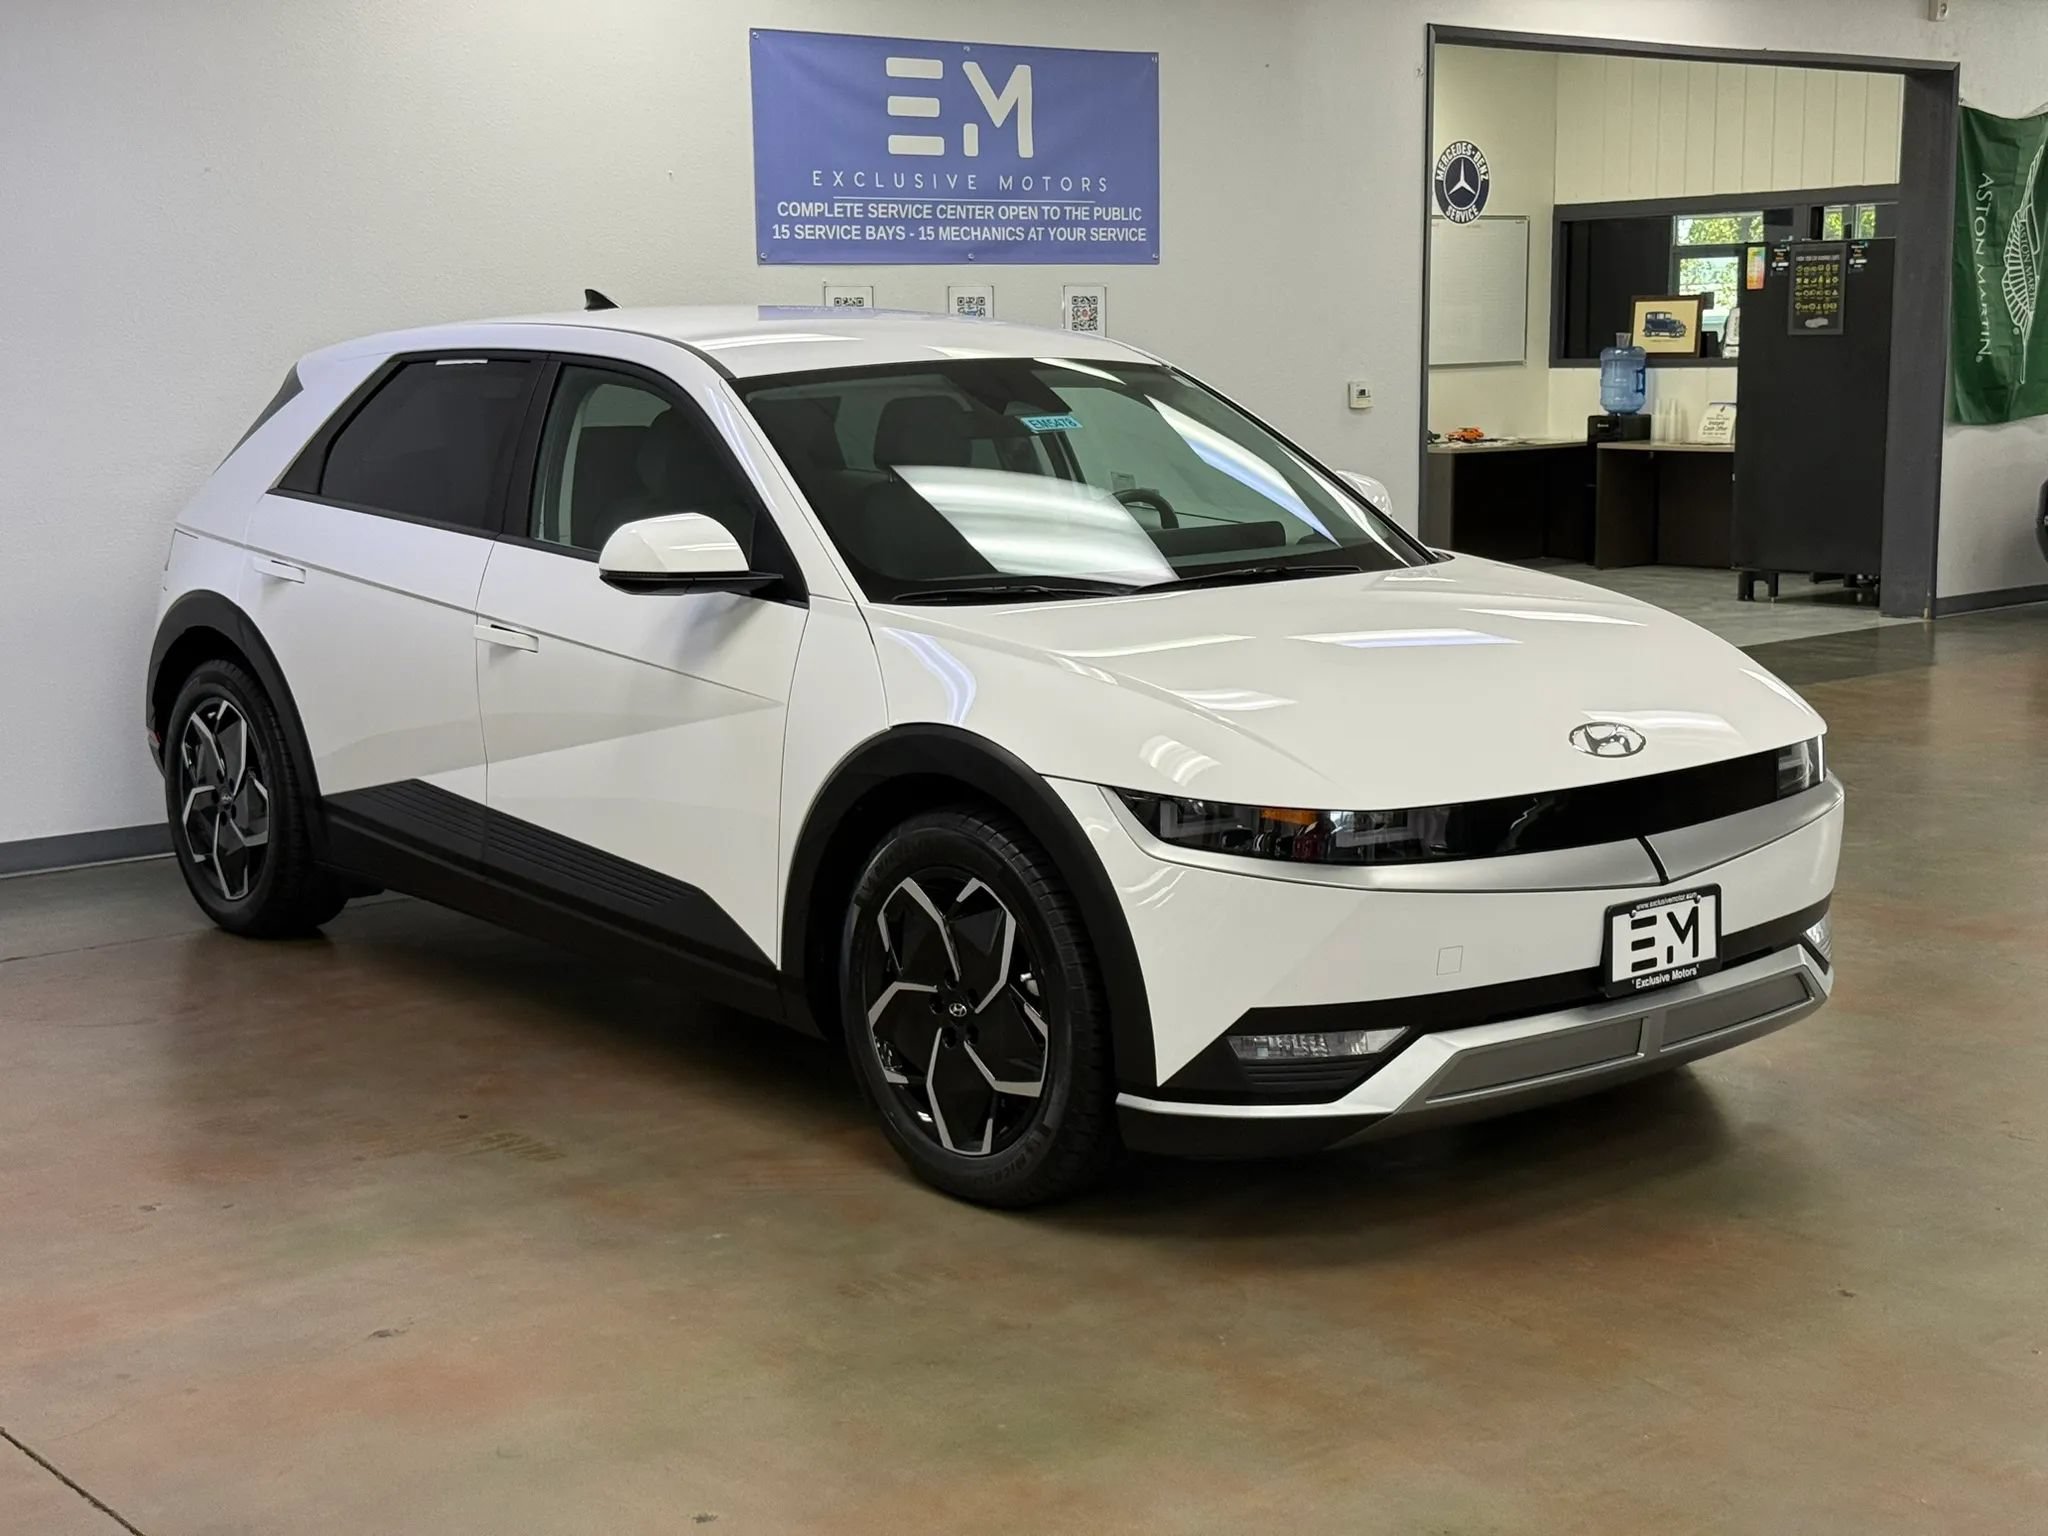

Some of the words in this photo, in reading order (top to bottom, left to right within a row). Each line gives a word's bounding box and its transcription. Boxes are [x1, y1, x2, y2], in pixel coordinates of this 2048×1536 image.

[886, 56, 1034, 158] EM
[812, 169, 978, 190] EXCLUSIVE
[999, 175, 1107, 193] MOTORS
[772, 223, 790, 240] 15
[794, 224, 861, 240] SERVICE
[865, 225, 905, 240] BAYS
[918, 226, 935, 240] 15
[938, 226, 1025, 241] MECHANICS
[1027, 227, 1045, 241] AT
[1048, 227, 1086, 241] YOUR
[1089, 228, 1147, 242] SERVICE
[777, 201, 864, 218] COMPLETE
[868, 203, 933, 219] SERVICE
[936, 204, 995, 220] CENTER
[998, 205, 1038, 220] OPEN
[1041, 206, 1061, 220] TO
[1064, 206, 1090, 220] THE
[1093, 207, 1142, 221] PUBLIC
[1446, 205, 1479, 222] SERVICE
[1974, 172, 1994, 255] ASTON
[1976, 263, 1993, 355] MARTIN
[1631, 905, 1699, 972] EM
